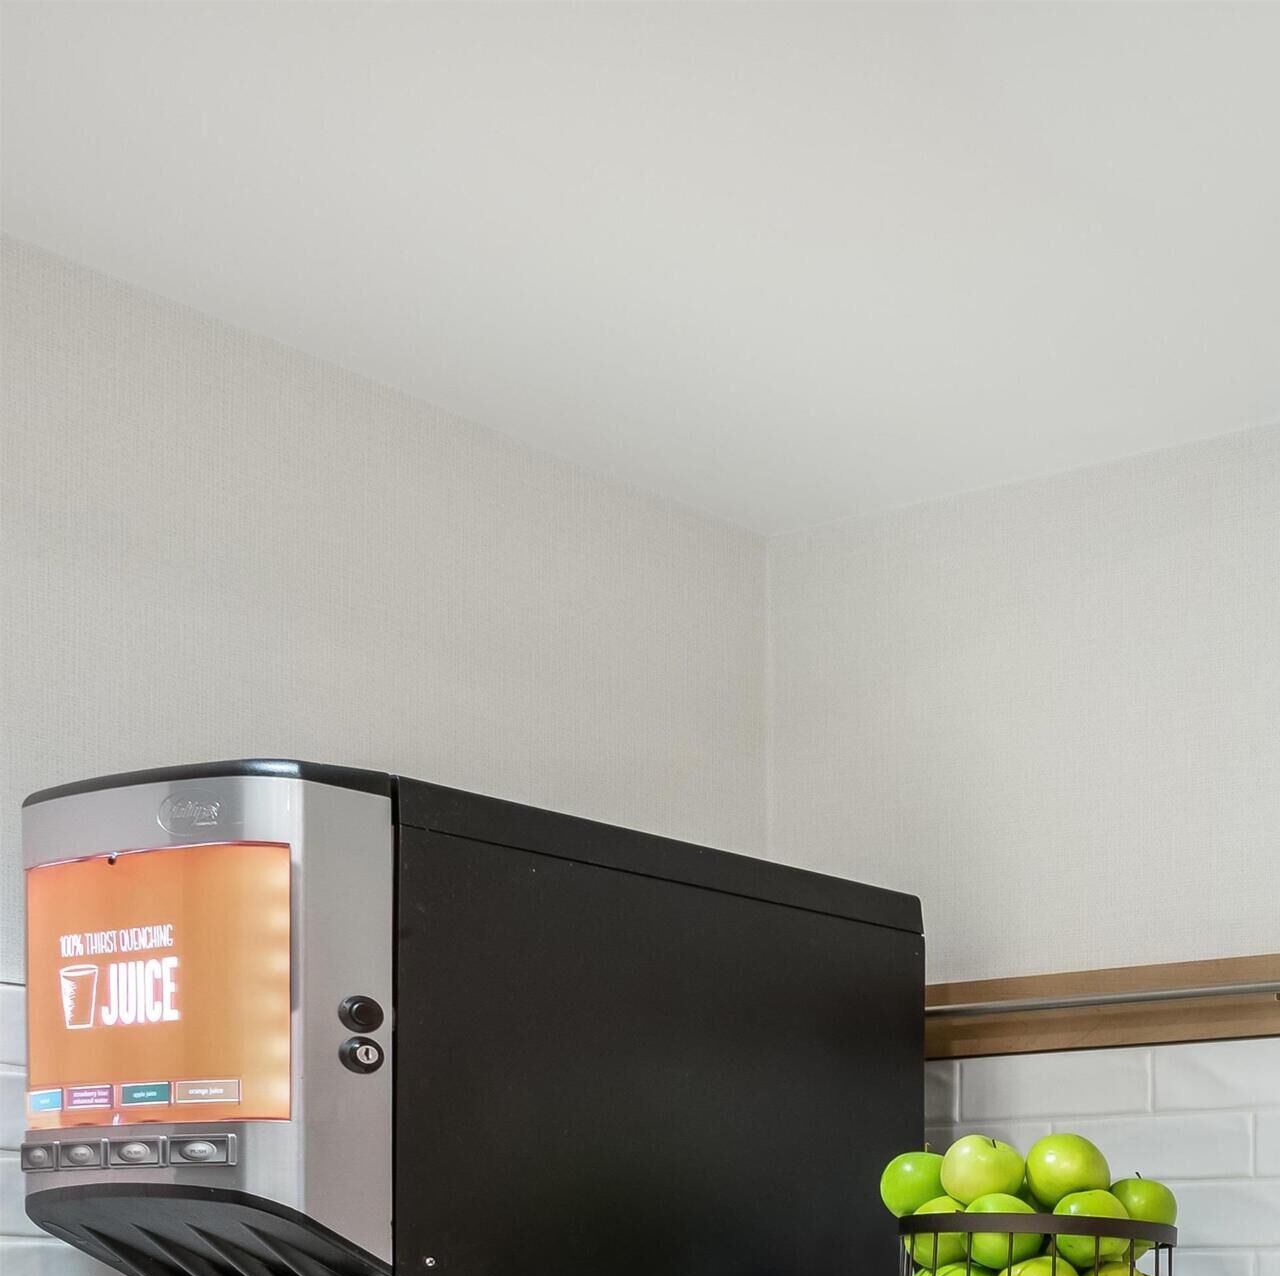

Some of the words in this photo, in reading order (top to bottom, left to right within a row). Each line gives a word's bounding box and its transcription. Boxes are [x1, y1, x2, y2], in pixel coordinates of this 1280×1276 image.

[60, 934, 84, 957] 100%
[84, 930, 118, 955] THIRST
[119, 924, 174, 952] QUENCHING
[101, 956, 179, 1025] JUICE
